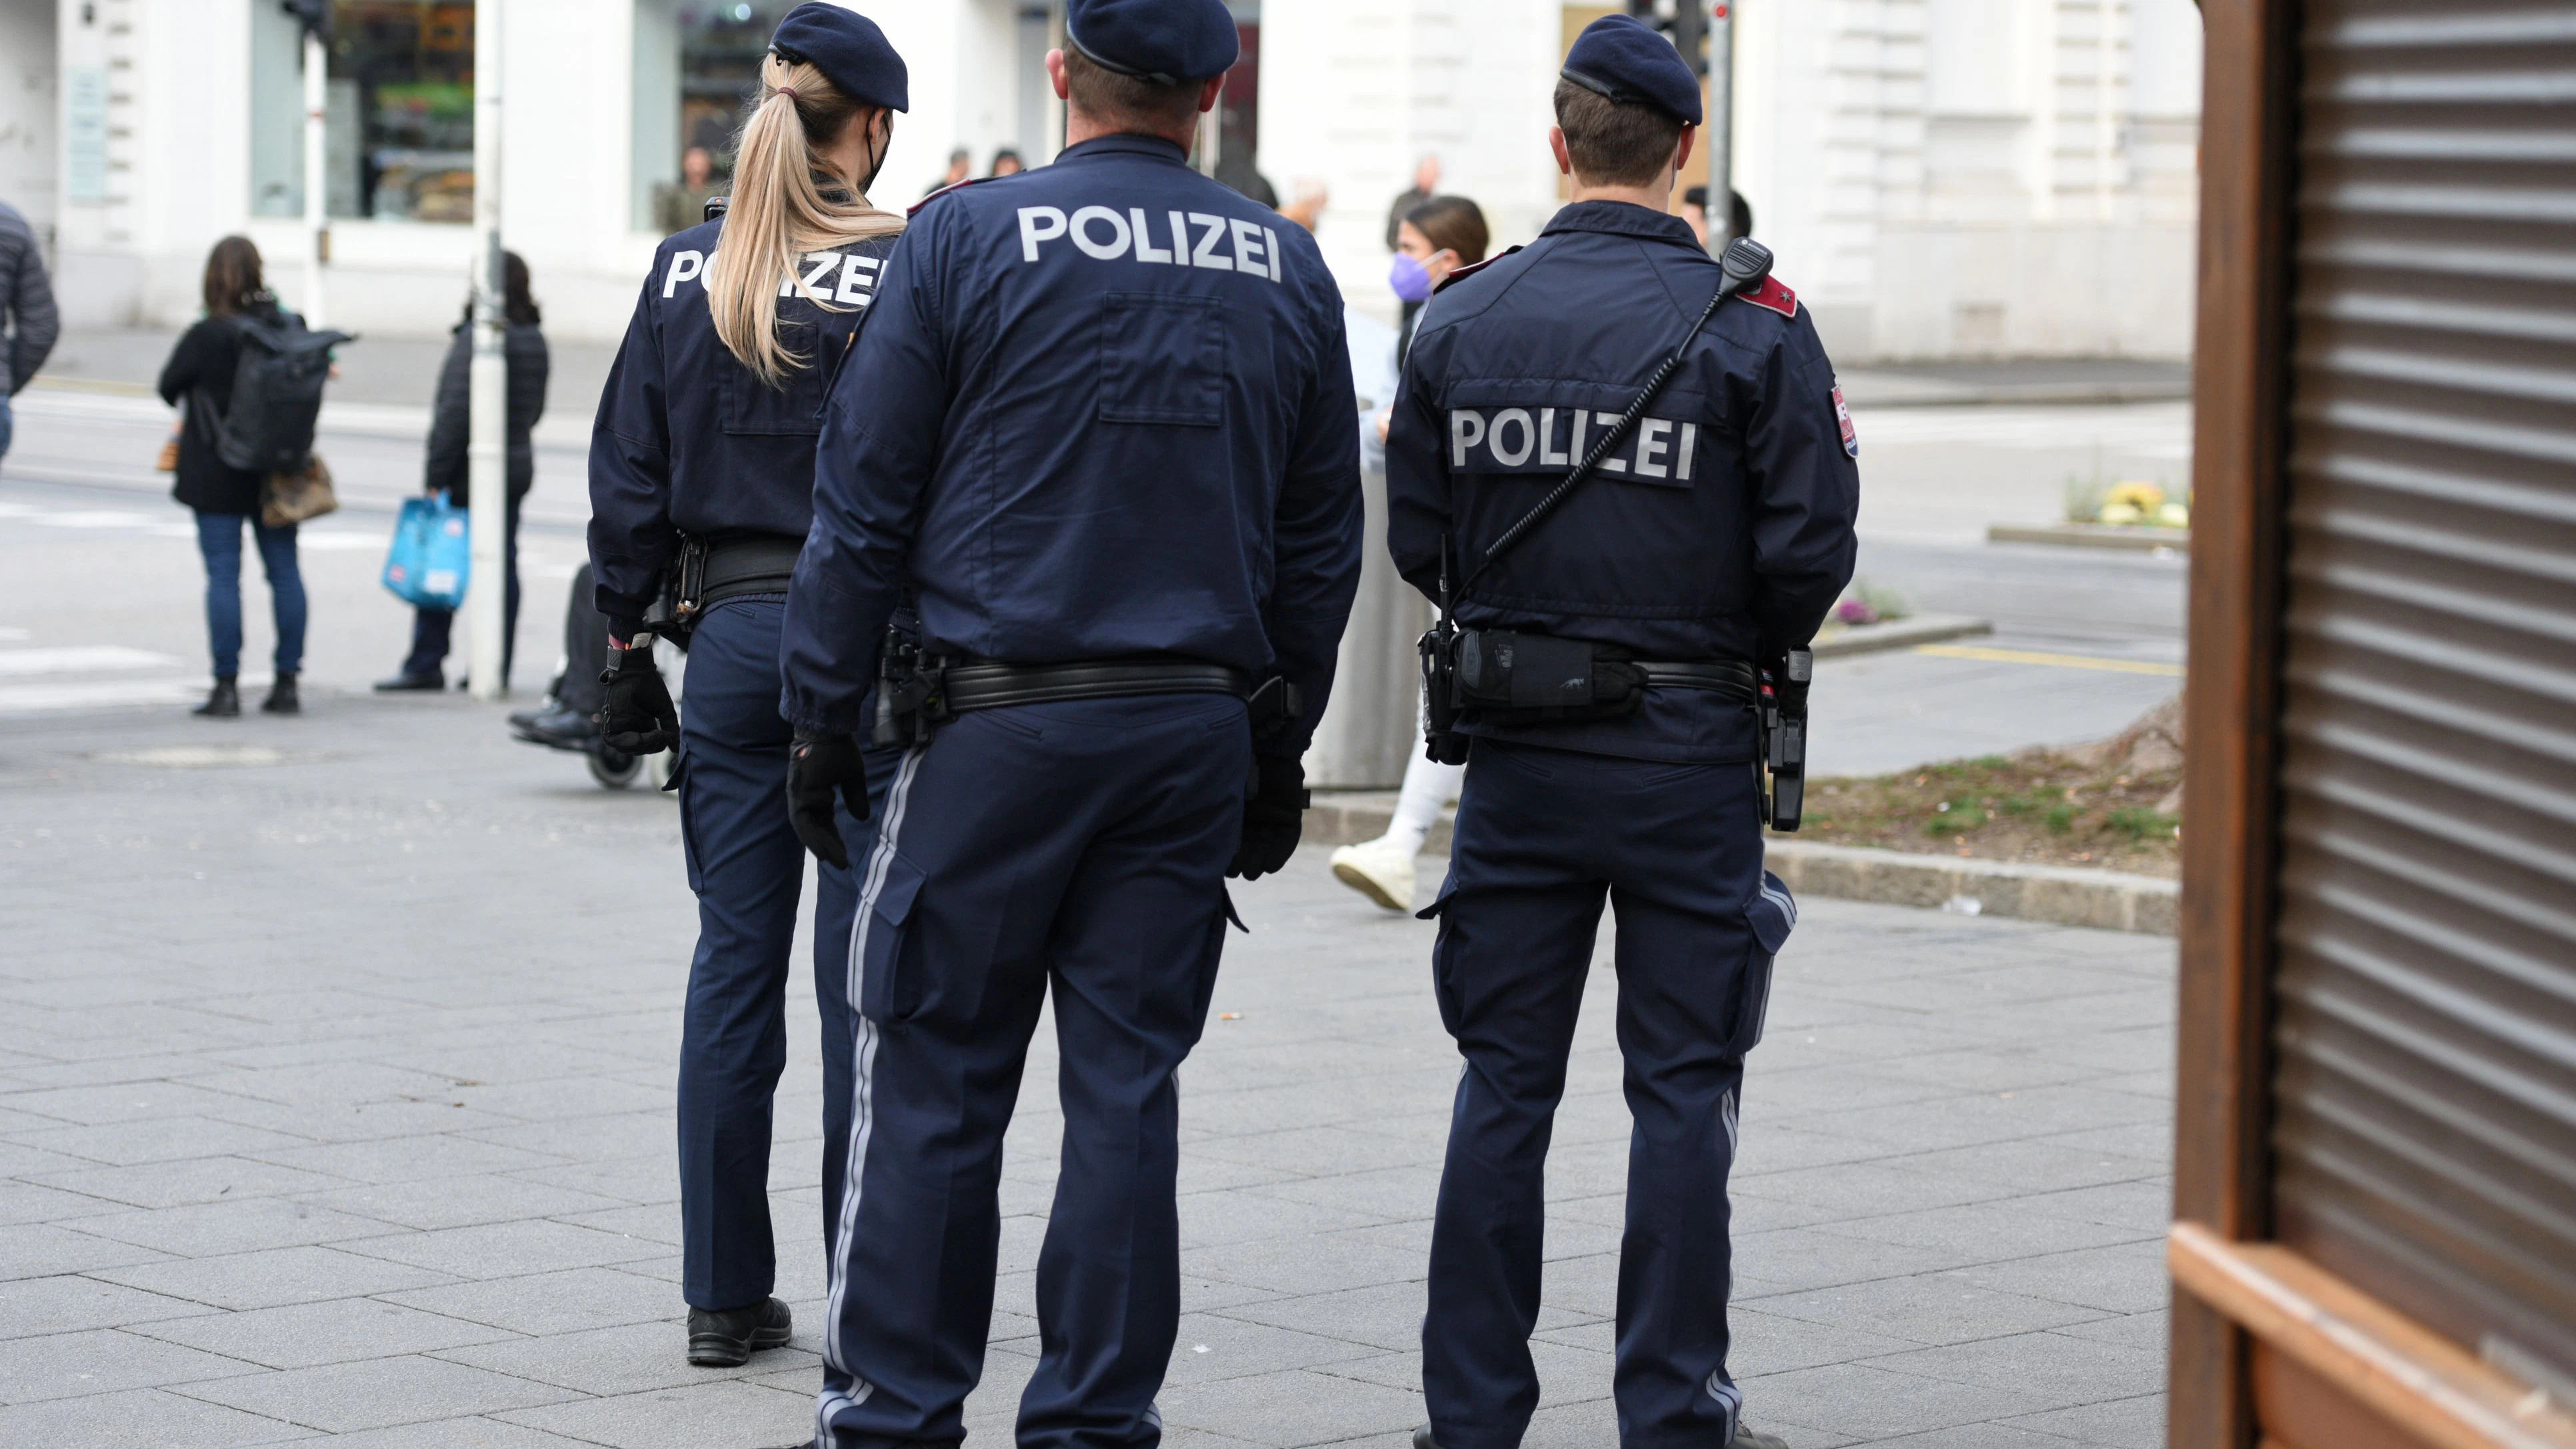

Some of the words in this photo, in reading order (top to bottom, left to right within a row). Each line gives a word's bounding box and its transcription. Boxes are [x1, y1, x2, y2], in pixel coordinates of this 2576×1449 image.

[663, 250, 889, 305] PIZE
[1017, 205, 1281, 283] POLIZEI
[1451, 407, 1696, 480] POLIZEI
